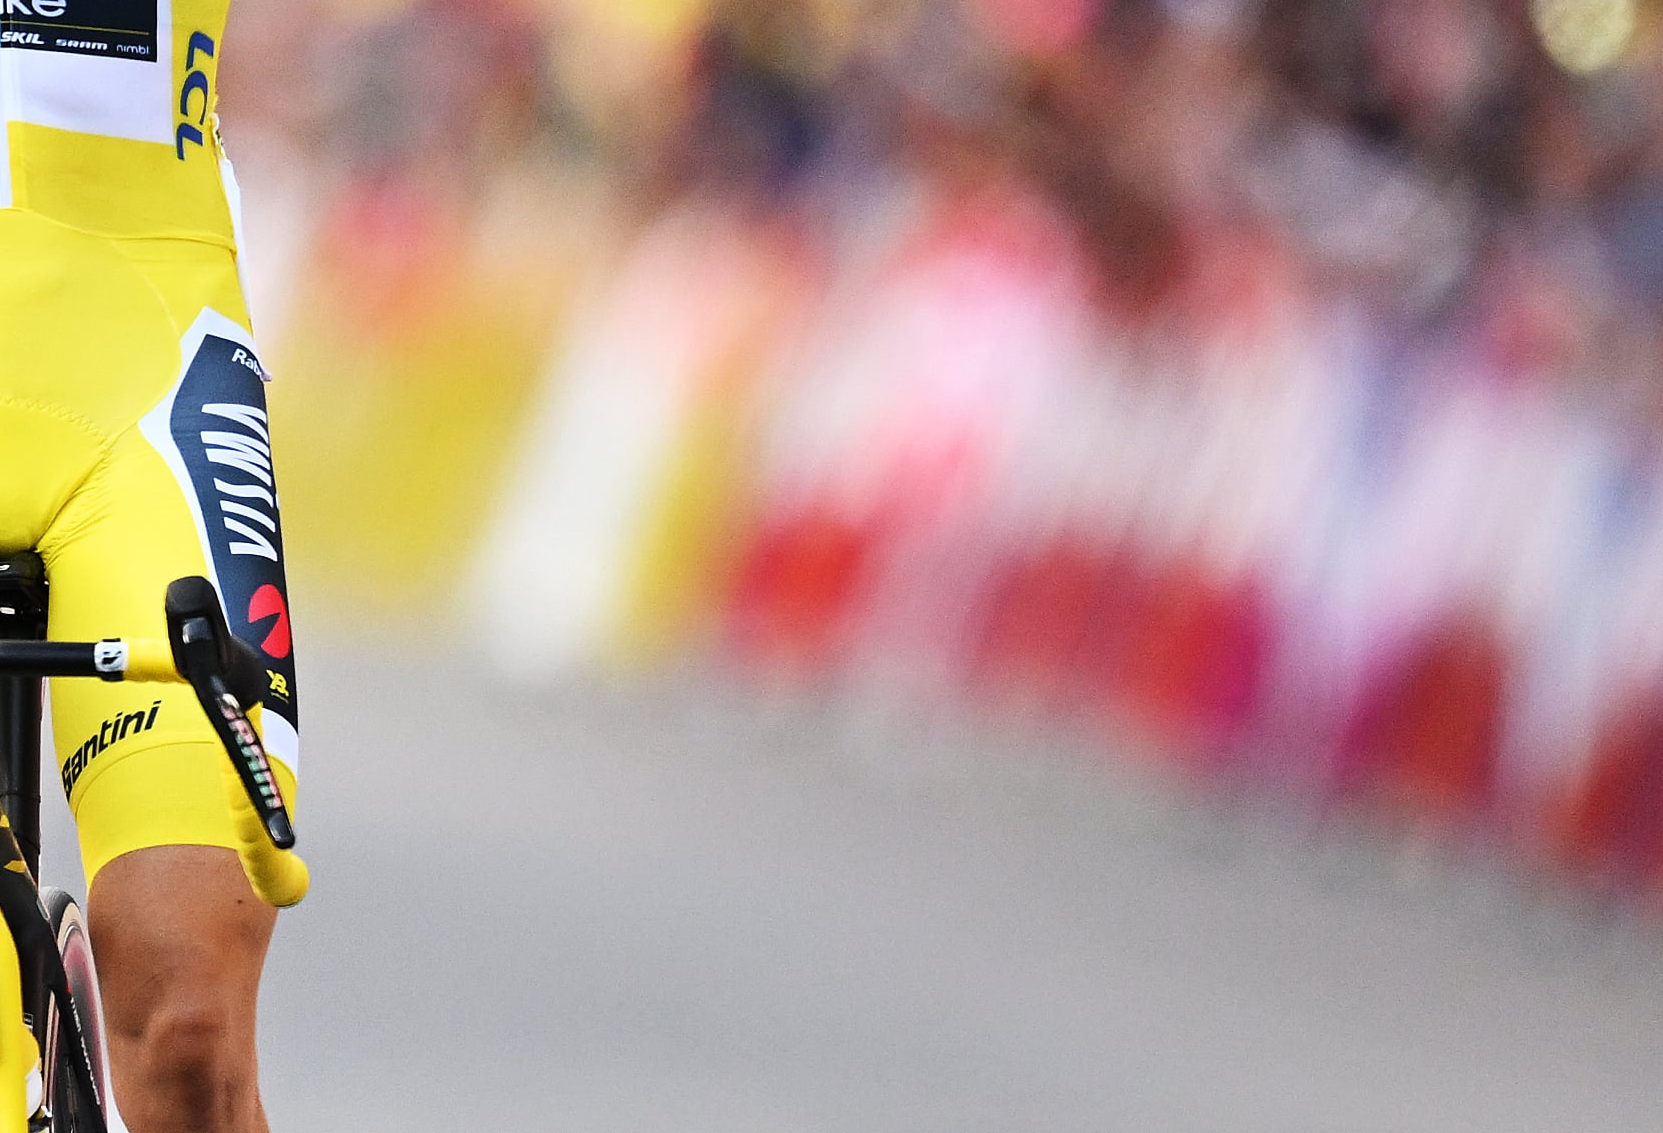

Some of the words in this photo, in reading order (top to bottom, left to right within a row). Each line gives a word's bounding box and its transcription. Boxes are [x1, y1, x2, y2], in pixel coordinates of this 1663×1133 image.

[0, 31, 45, 45] SKIL
[116, 43, 150, 56] nimbl
[176, 31, 215, 161] LCL
[200, 403, 278, 562] VISMA
